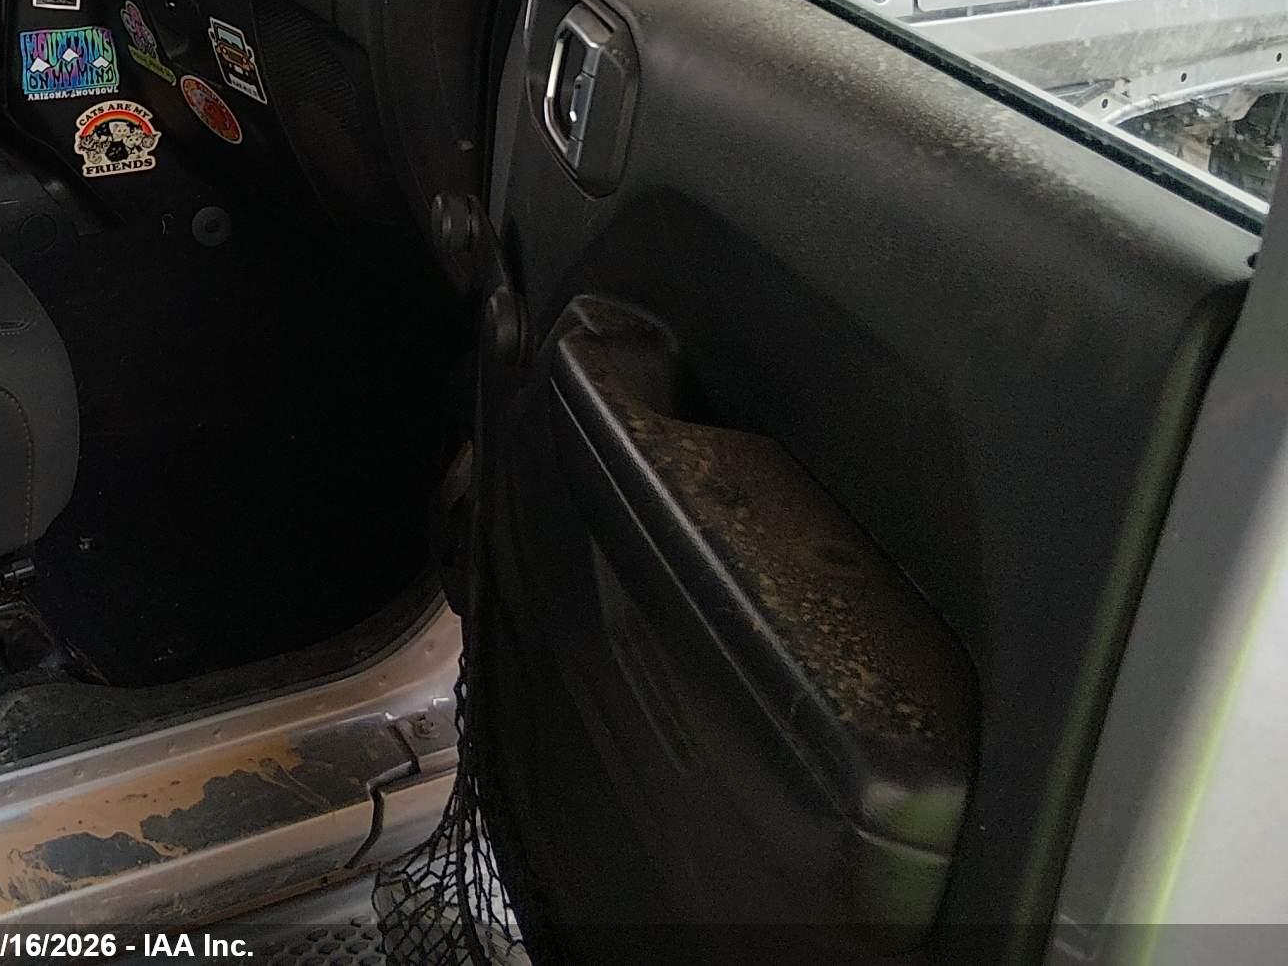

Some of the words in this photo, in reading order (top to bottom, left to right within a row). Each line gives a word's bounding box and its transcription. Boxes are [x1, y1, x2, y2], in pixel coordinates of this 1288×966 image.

[24, 27, 114, 69] MOUNTAINS
[29, 73, 49, 90] ON
[51, 59, 76, 88] MY
[76, 58, 114, 87] MIND
[79, 105, 105, 126] CATS
[108, 103, 132, 111] ARE
[133, 107, 150, 118] MY
[85, 157, 153, 174] FRIENDS
